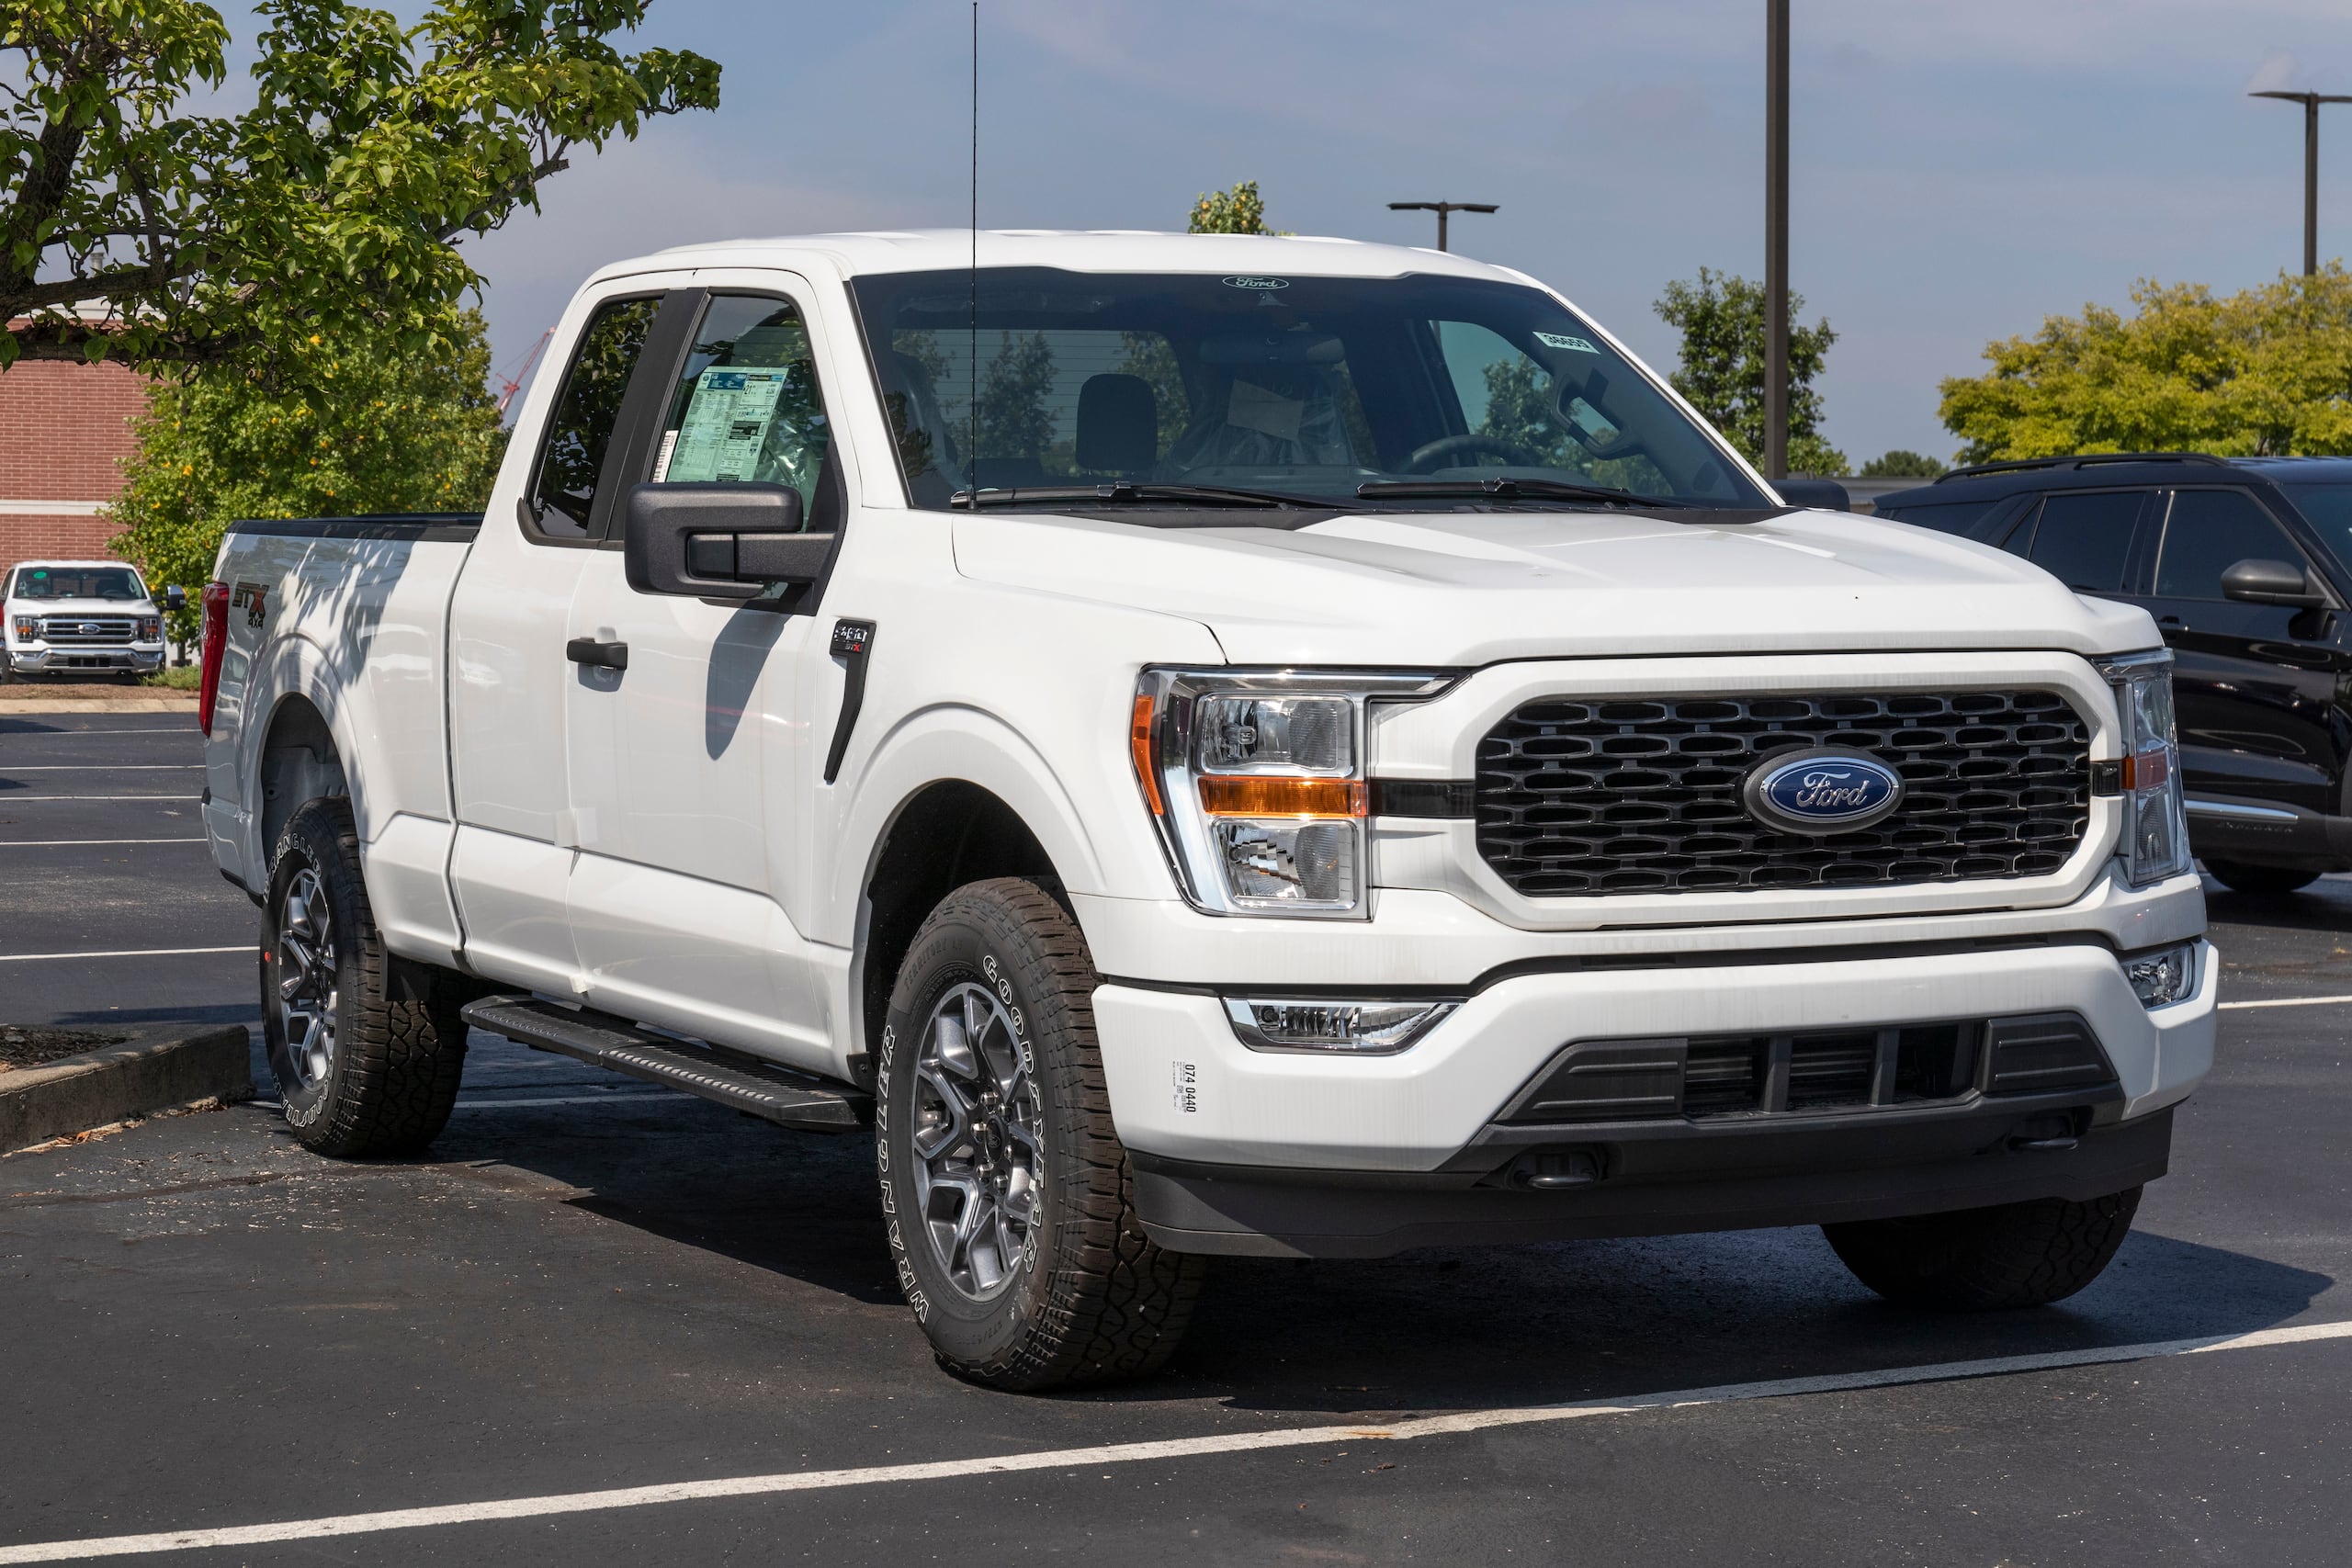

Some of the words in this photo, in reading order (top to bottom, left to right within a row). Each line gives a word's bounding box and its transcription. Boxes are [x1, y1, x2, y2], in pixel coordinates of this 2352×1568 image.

[1236, 277, 1278, 288] Ford
[232, 581, 270, 619] STX
[1796, 772, 1870, 807] Ford
[1184, 1064, 1195, 1083] 074
[982, 954, 1046, 1273] GOODYEAR
[1185, 1087, 1196, 1112] 0440
[876, 1024, 930, 1324] WRANGLER
